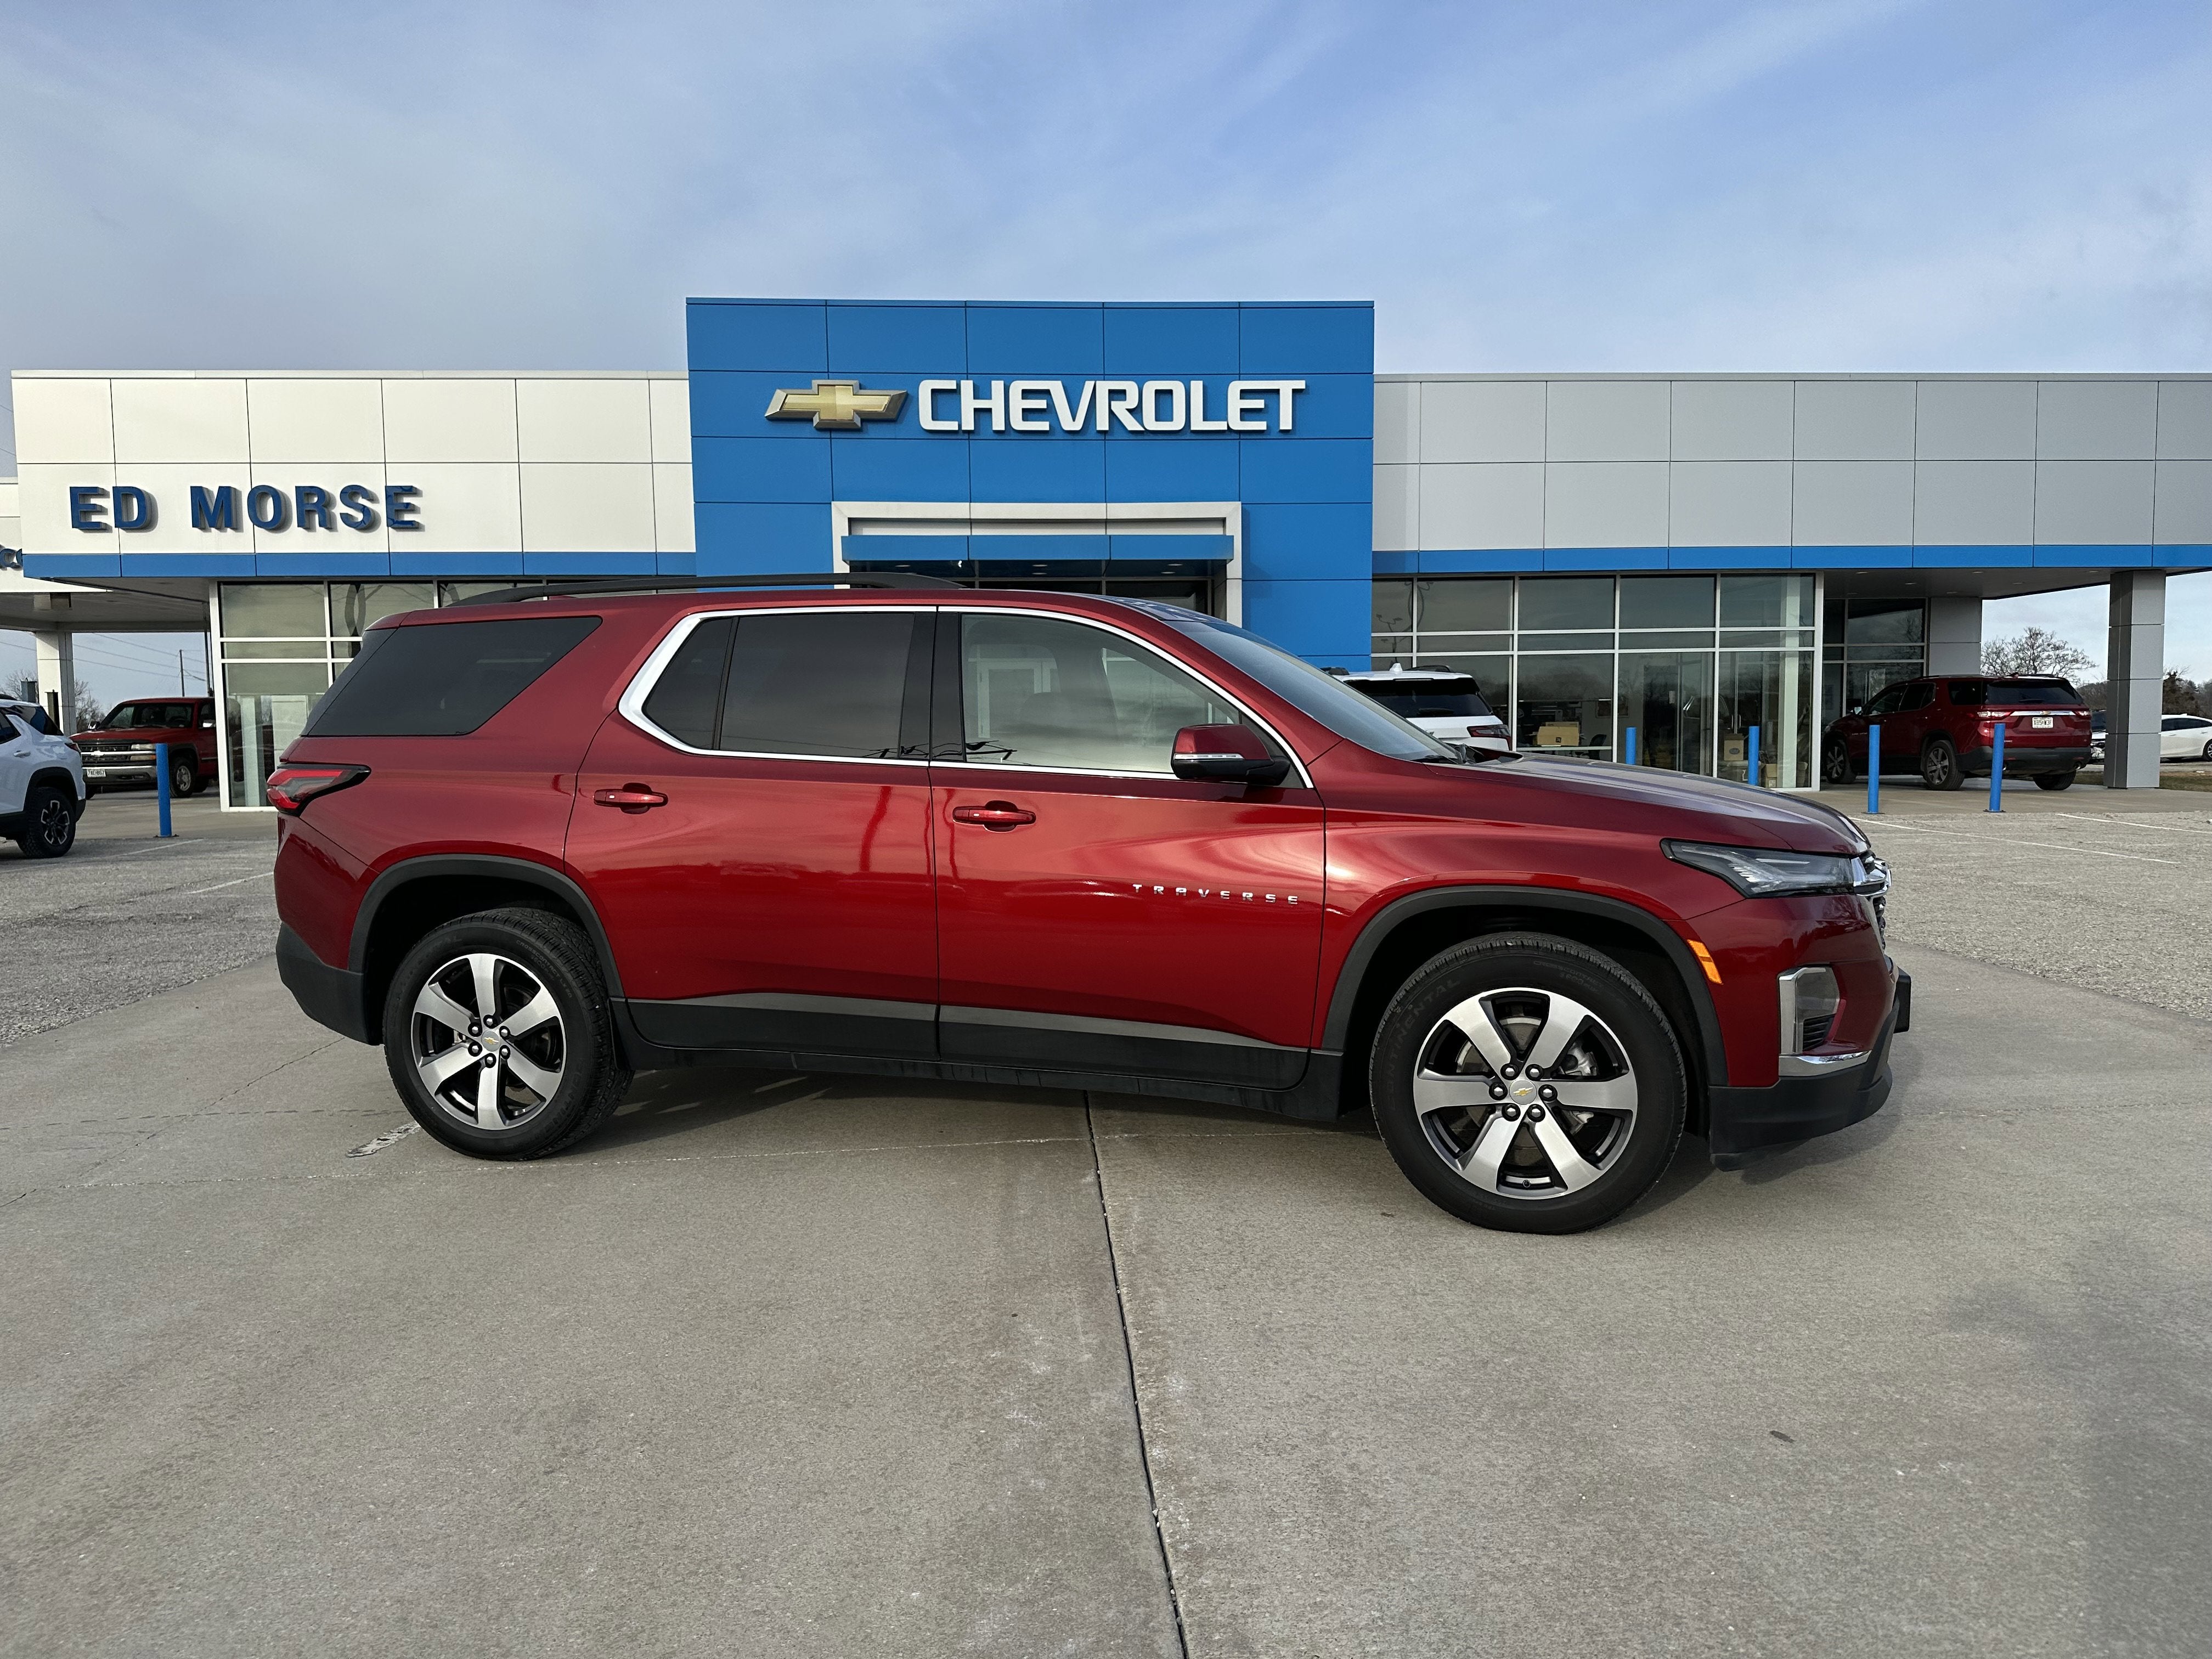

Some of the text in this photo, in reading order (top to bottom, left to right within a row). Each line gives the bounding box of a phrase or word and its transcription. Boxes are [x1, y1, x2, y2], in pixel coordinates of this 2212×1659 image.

[918, 380, 1306, 431] CHEVROLET
[69, 484, 418, 531] ED MORSE
[1132, 883, 1299, 905] TRAVERSE
